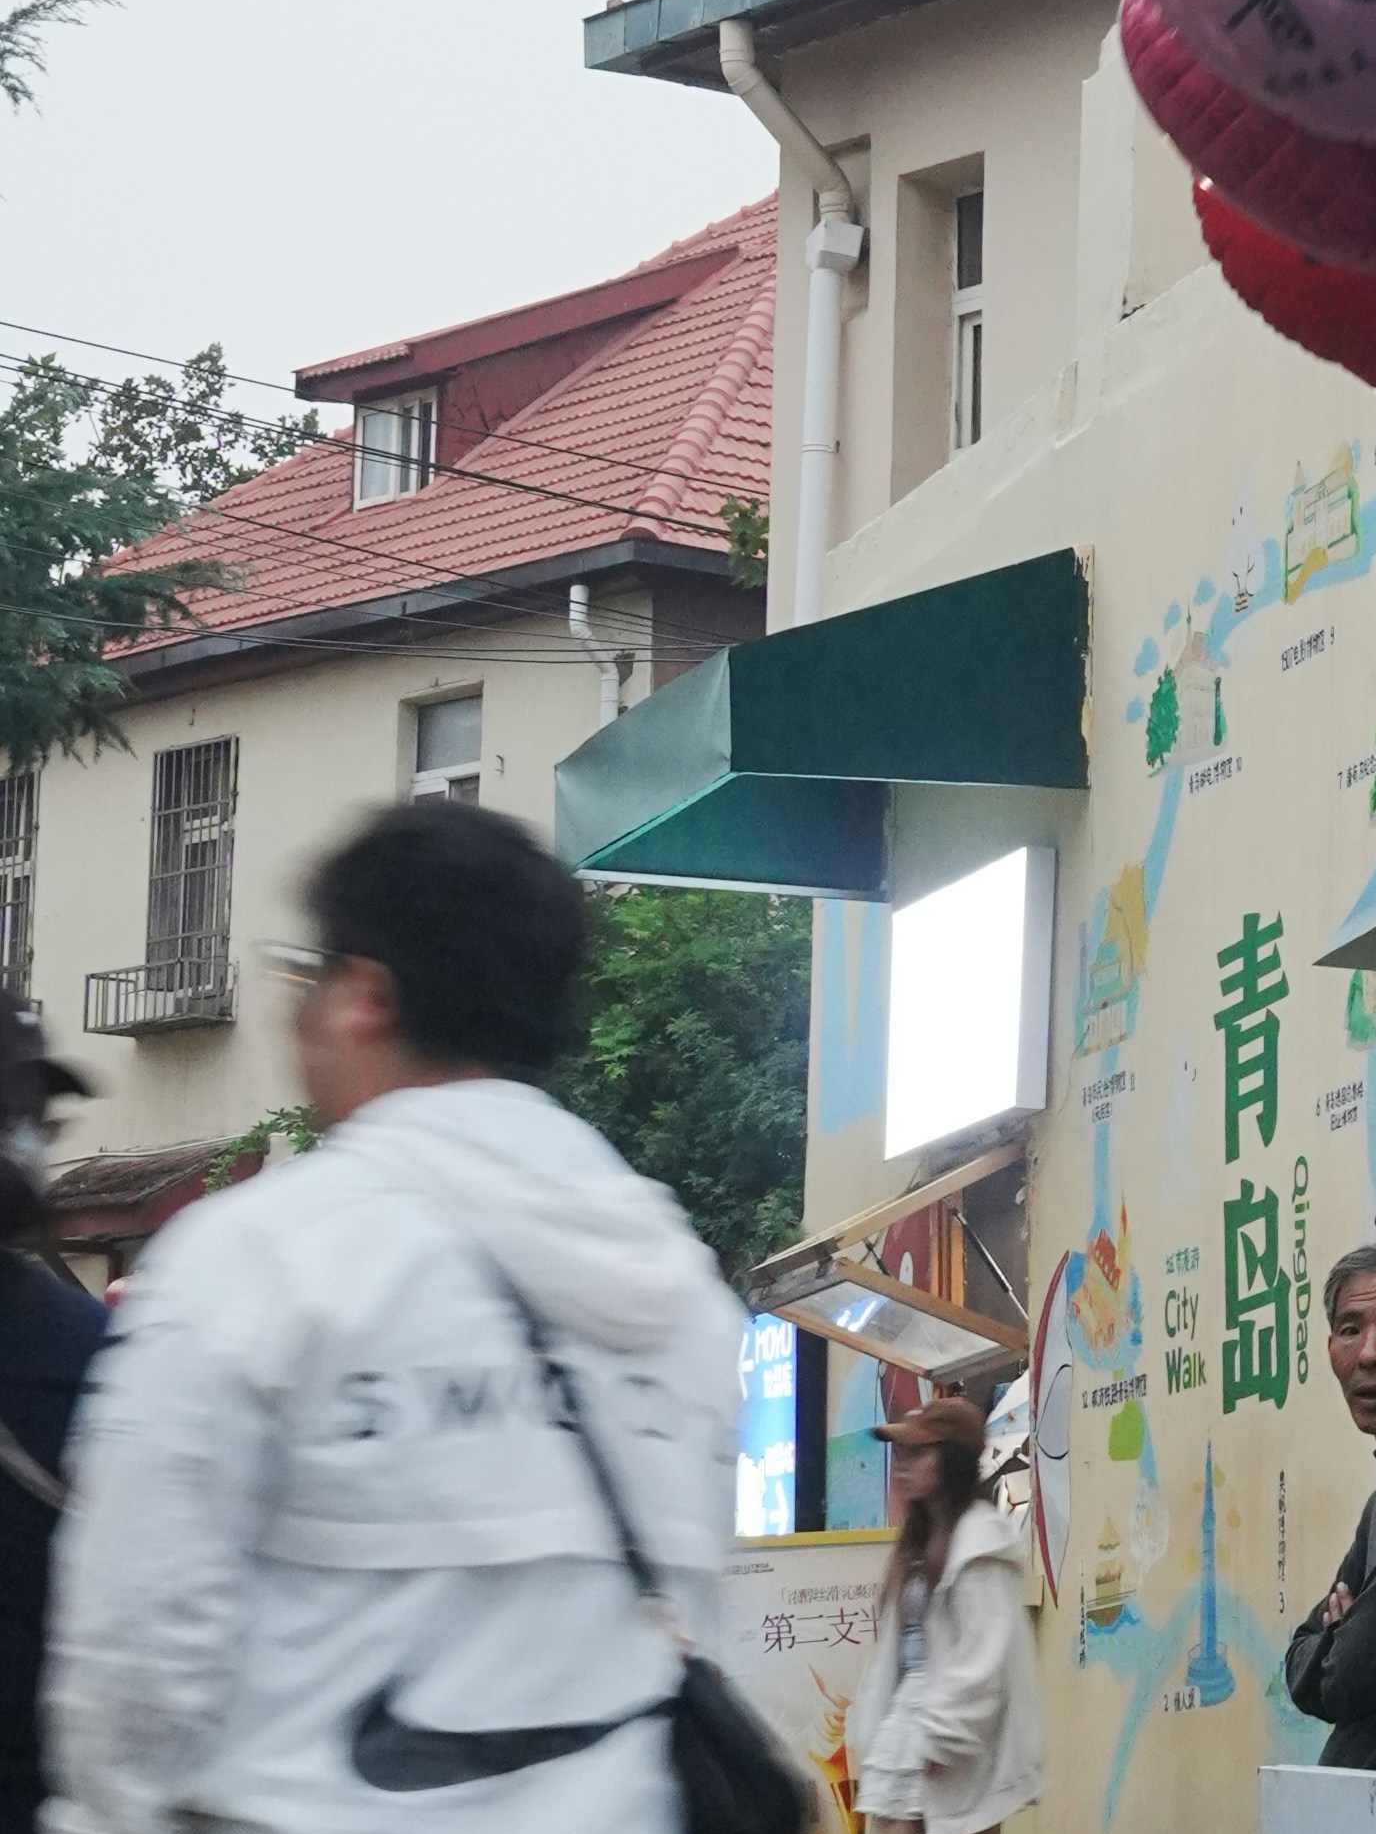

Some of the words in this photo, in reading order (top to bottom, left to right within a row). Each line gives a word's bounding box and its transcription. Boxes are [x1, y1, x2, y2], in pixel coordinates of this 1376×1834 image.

[1213, 909, 1292, 1415] 青岛
[1165, 1286, 1199, 1341] City
[1165, 1347, 1207, 1396] Walk
[1279, 1591, 1285, 1614] 3
